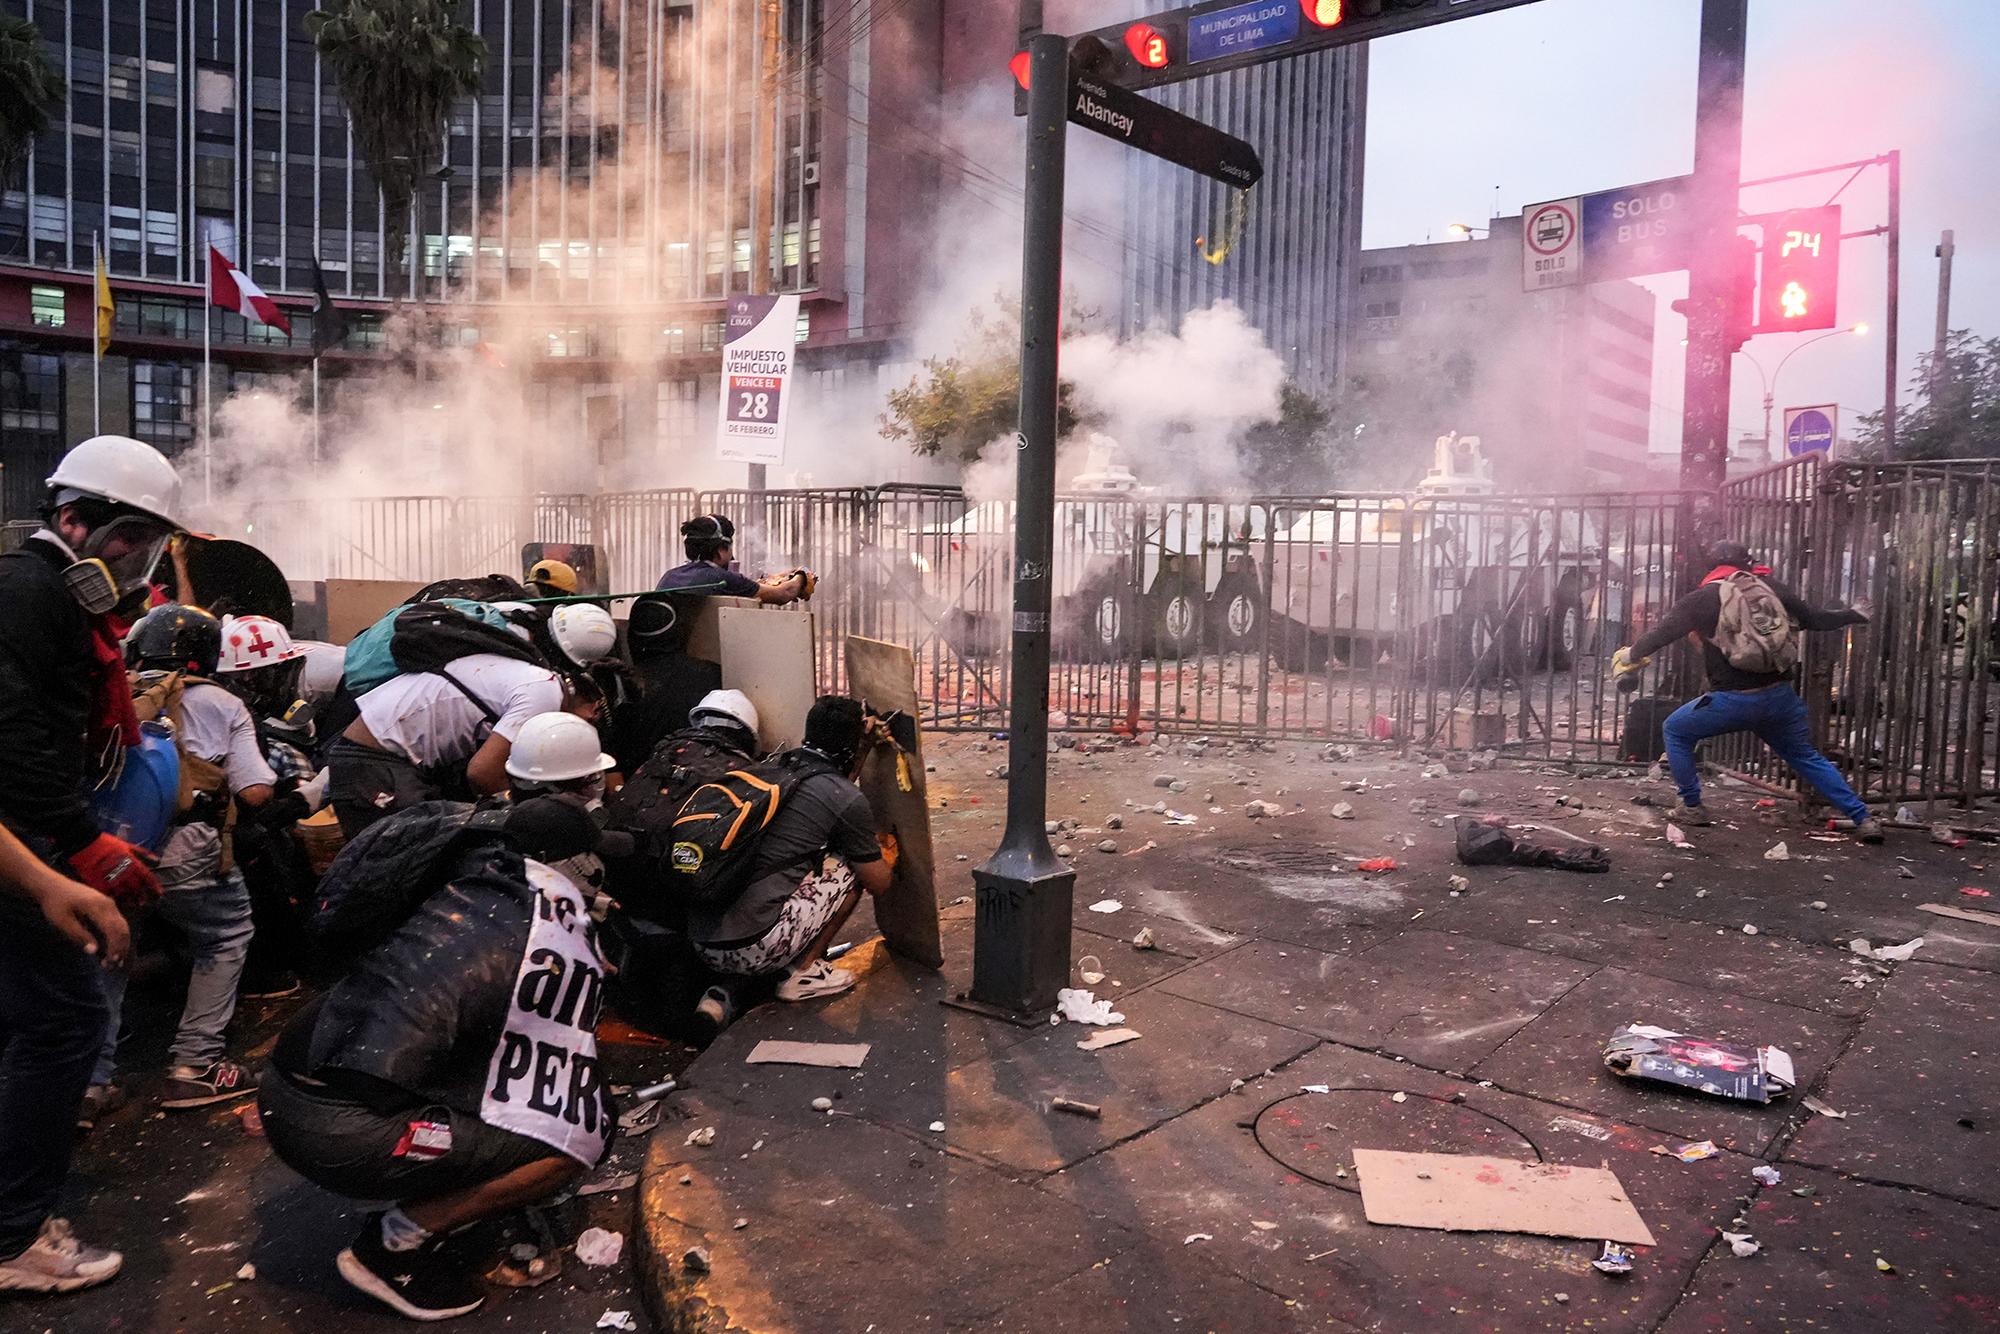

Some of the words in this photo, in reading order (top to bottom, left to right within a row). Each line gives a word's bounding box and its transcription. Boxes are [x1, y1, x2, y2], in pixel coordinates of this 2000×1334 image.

[1200, 5, 1287, 35] MUNICIPALIDAD
[1220, 33, 1235, 47] DE
[1237, 27, 1265, 42] LIMA
[1149, 39, 1162, 62] 2
[1077, 77, 1107, 98] Avenida
[1076, 94, 1134, 136] Abancay
[1612, 191, 1675, 219] SOLO
[1617, 219, 1667, 243] BUS
[1535, 256, 1566, 271] SOLO
[1538, 271, 1563, 286] BUS
[730, 349, 786, 362] IMPUESTO
[727, 361, 787, 375] VEHICULAR
[735, 377, 765, 388] VENCE
[765, 378, 776, 388] EL
[738, 391, 769, 419] 28
[728, 424, 738, 433] DE
[740, 425, 775, 435] FEBRERO
[491, 1030, 612, 1140] PER
